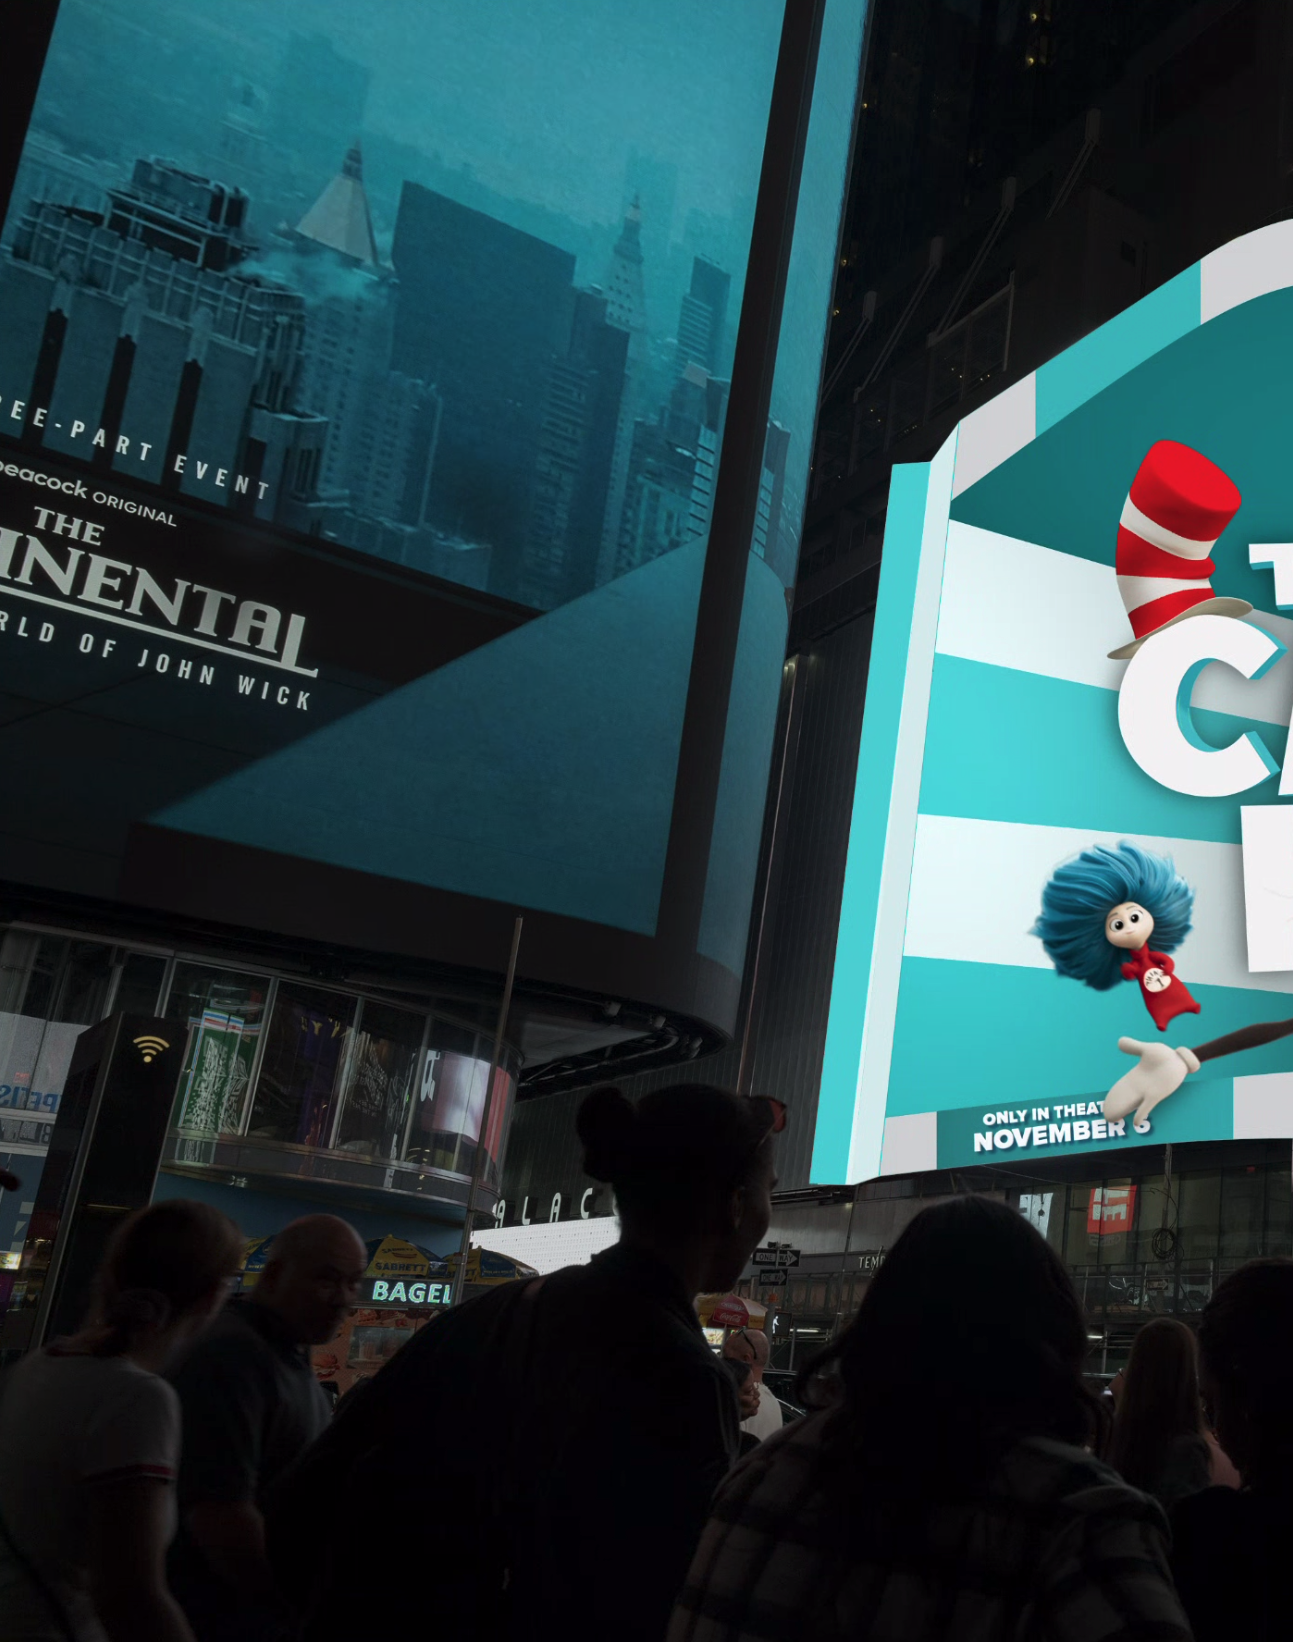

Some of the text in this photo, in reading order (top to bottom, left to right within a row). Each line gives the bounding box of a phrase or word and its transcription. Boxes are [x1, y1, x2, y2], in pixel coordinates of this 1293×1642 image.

[0, 395, 269, 499] EE-PART EVENT
[33, 505, 105, 546] THE
[93, 491, 177, 528] ORIGINAL
[80, 633, 116, 657] OF
[137, 649, 215, 685] JOHN
[238, 675, 311, 710] WICK
[974, 1117, 1126, 1152] NOVEMBER
[983, 1109, 1028, 1126] ONLY
[1032, 1107, 1050, 1121] IN
[375, 1262, 426, 1272] SABRETT
[759, 1253, 773, 1261] ONE
